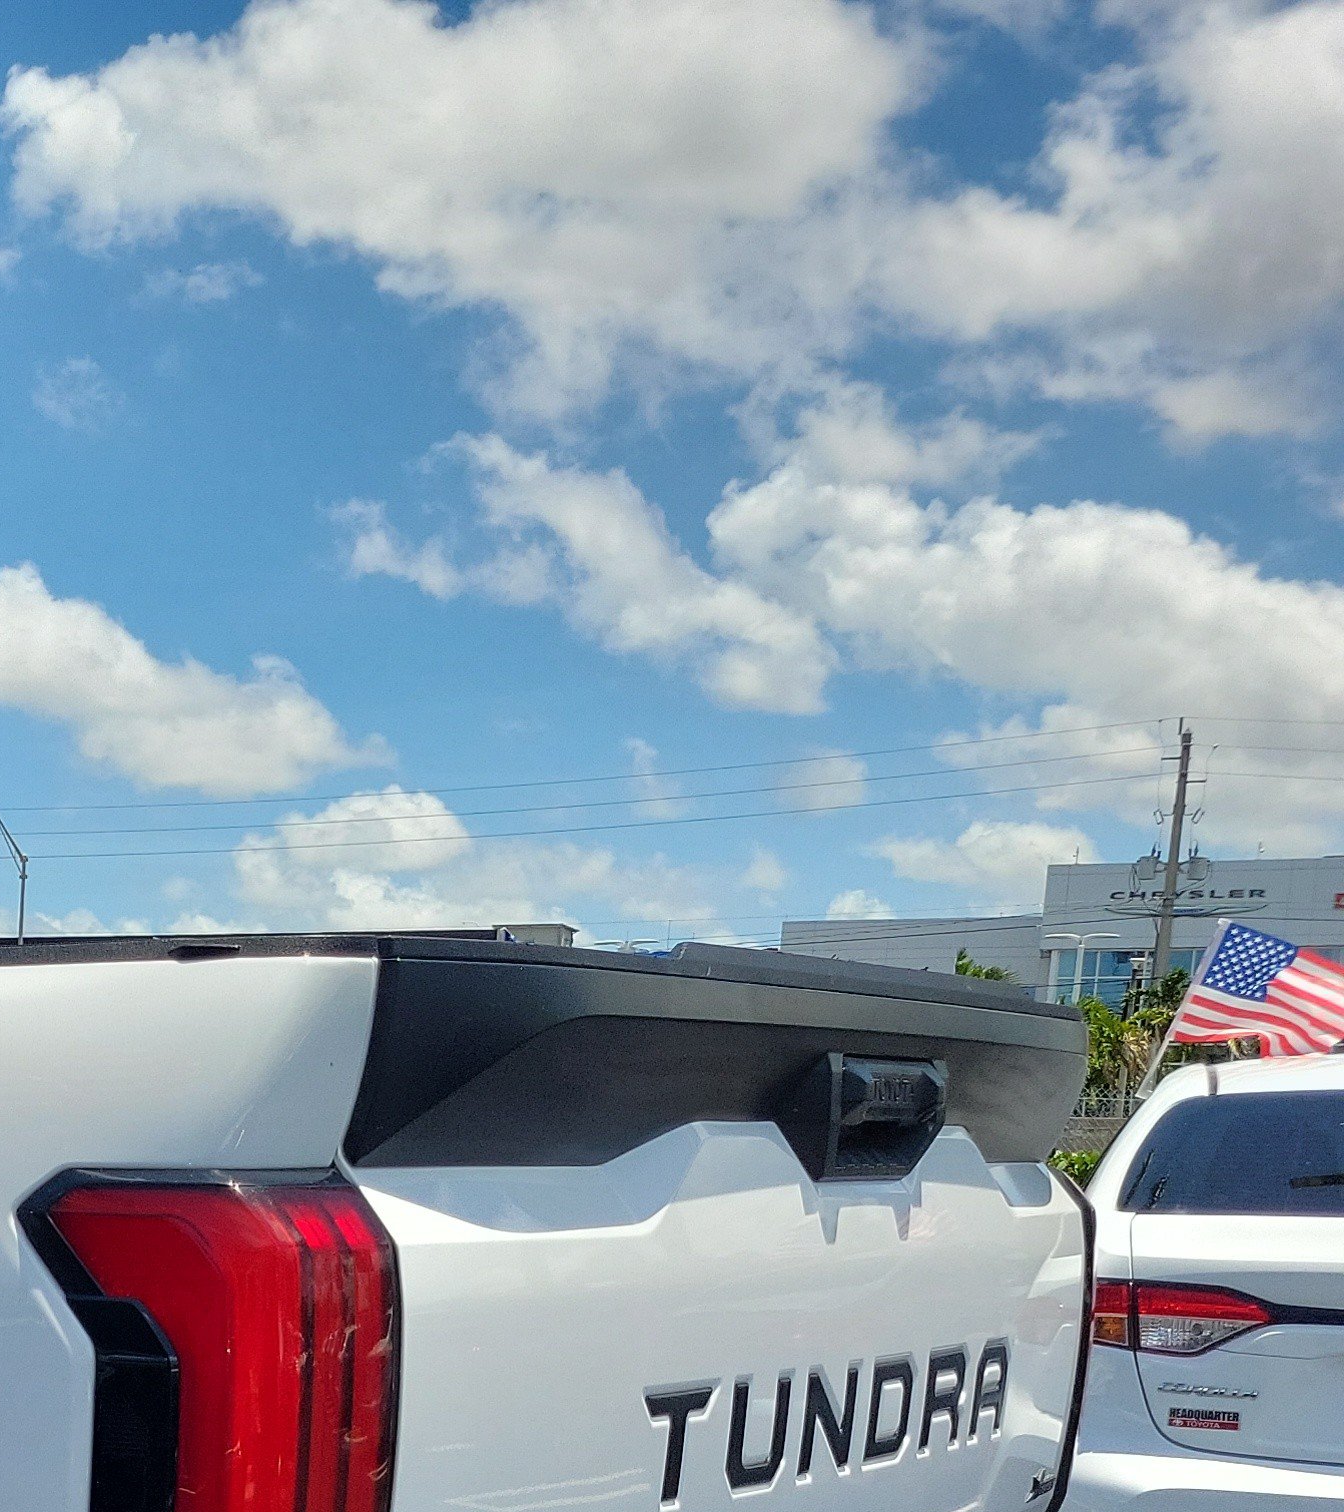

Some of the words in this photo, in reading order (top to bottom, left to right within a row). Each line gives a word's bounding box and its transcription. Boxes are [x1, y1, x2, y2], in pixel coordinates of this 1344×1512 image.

[1169, 1407, 1240, 1422] HEADQUARTER
[643, 1336, 1010, 1512] TUNDRA
[1186, 1420, 1221, 1429] TOYOTA
